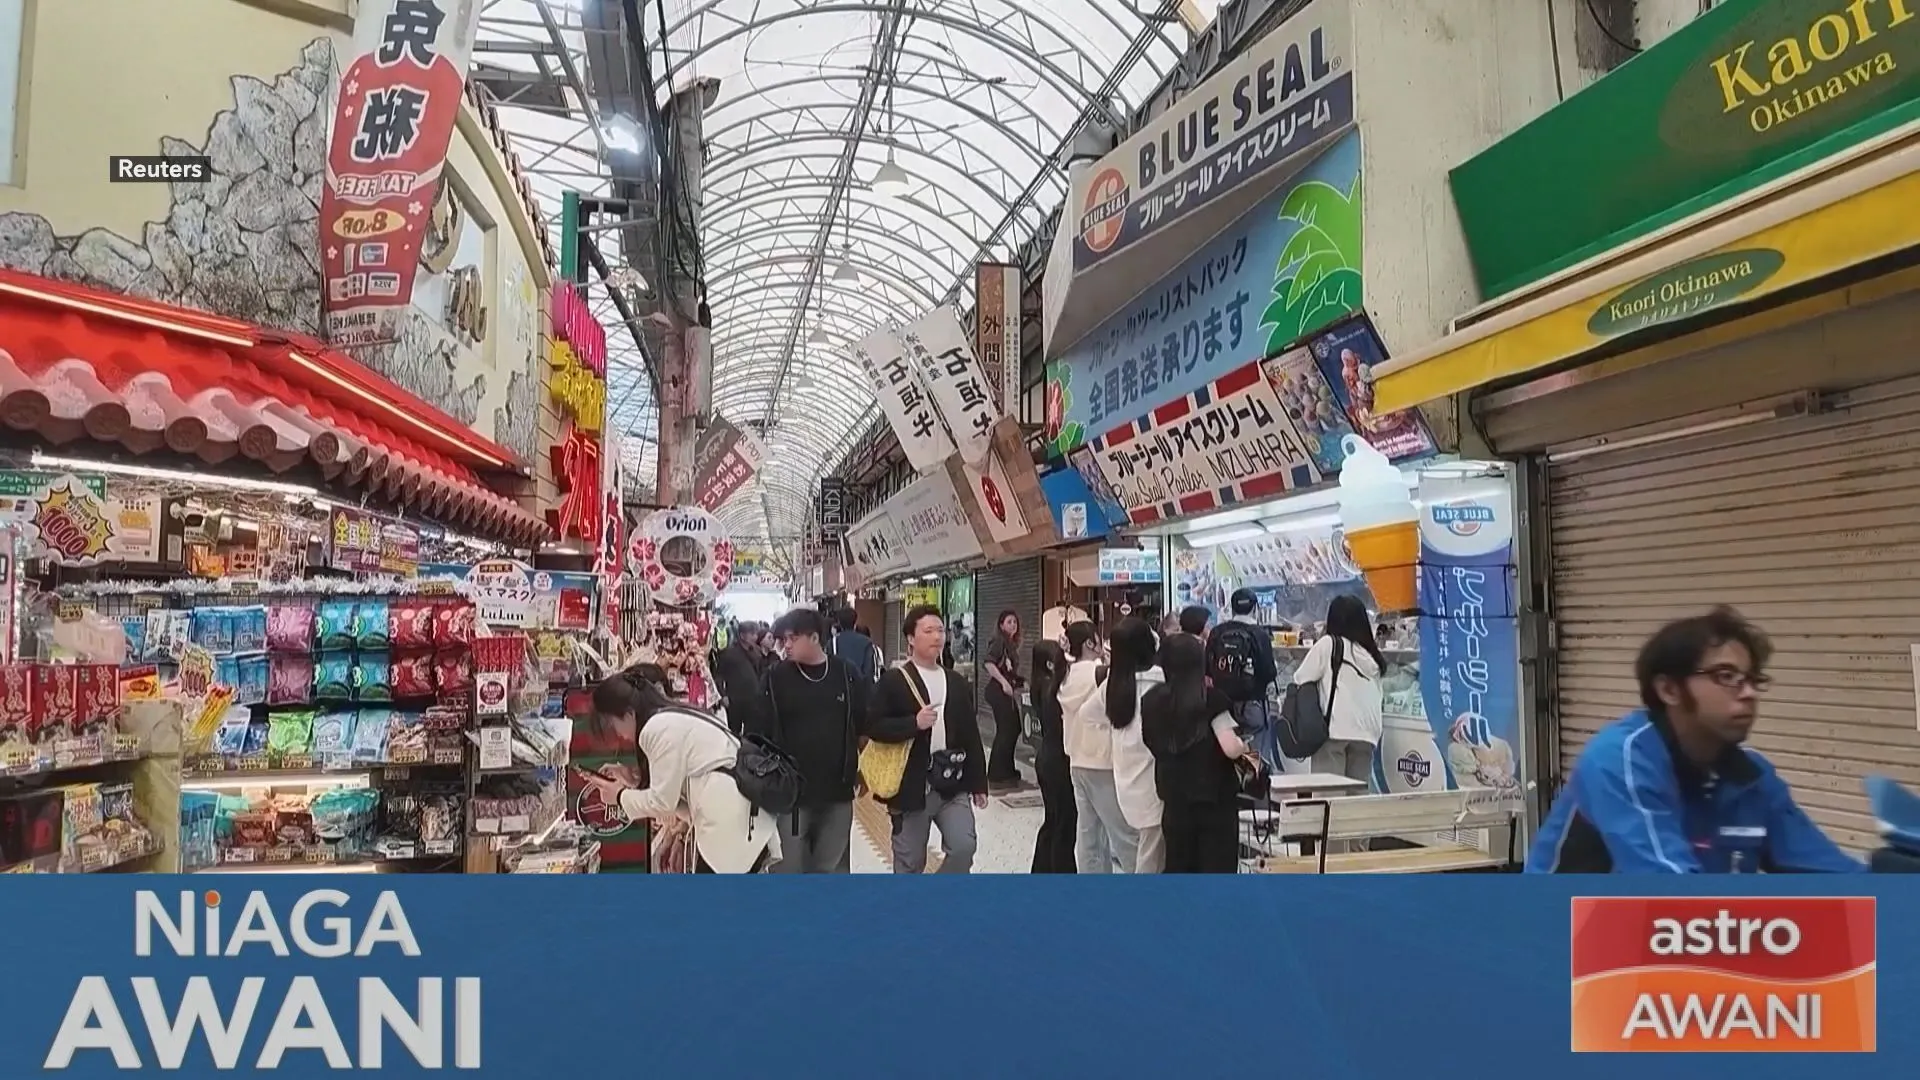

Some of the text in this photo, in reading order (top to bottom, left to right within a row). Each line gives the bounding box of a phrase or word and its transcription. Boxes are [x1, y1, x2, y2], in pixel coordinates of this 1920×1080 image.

[1710, 0, 1915, 113] Kaori
[1750, 49, 1897, 134] Okinawa
[1139, 26, 1332, 190] BLUE SEAL
[1138, 96, 1332, 231] ブルーシール アイスクリーム
[1083, 195, 1128, 231] BLUE SEAL
[1609, 260, 1753, 323] Kaori Okinawa
[1088, 289, 1251, 424] 全国発送承ります
[1108, 393, 1275, 480] ブルーシール アイスクリーム
[1113, 428, 1305, 510] Blue Seal Parlor MIZUHARA
[41, 507, 90, 557] 1000
[666, 514, 707, 532] Orion
[1414, 761, 1429, 774] SEAL
